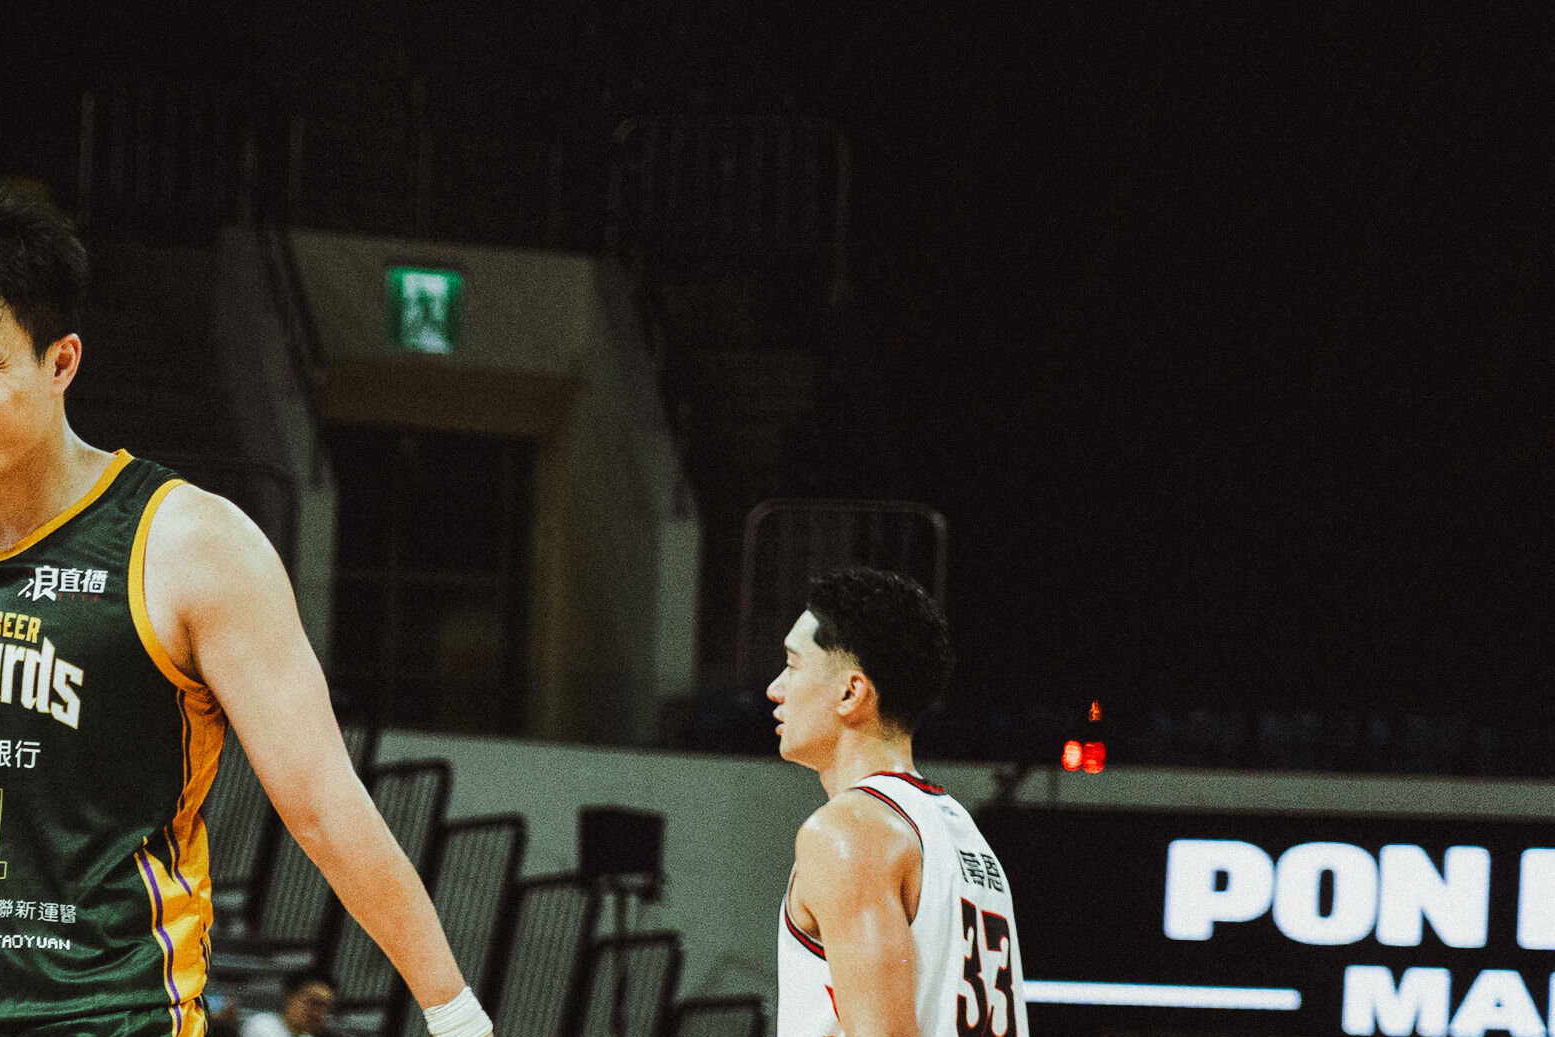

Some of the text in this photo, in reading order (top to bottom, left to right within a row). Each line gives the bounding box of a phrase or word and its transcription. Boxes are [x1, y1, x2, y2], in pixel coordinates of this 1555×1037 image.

[17, 565, 108, 601] 浪直播
[1164, 838, 1491, 948] PON
